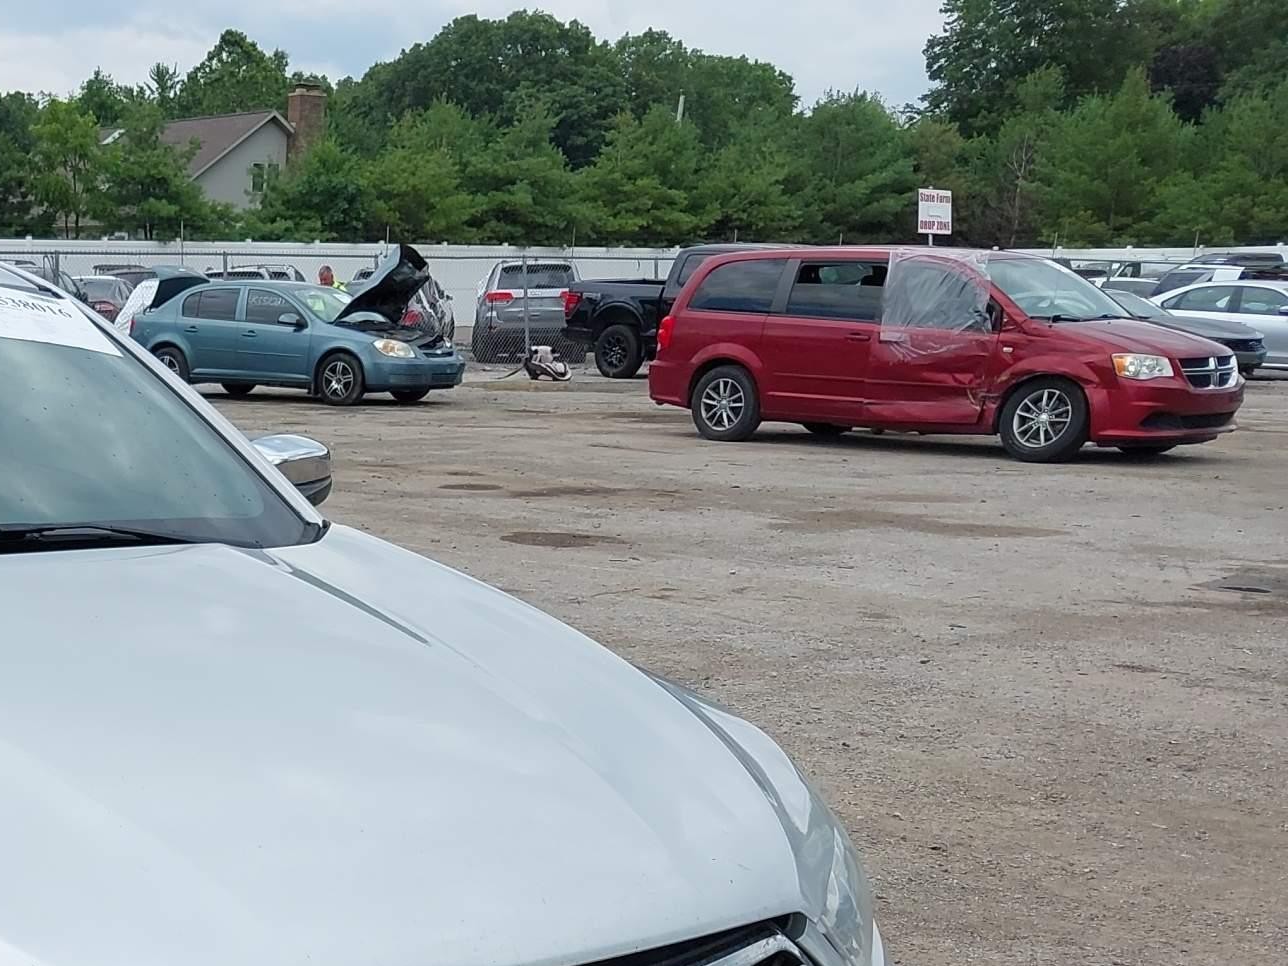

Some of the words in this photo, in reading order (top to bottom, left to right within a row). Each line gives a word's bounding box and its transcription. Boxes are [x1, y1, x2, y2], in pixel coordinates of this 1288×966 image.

[920, 192, 935, 203] State
[936, 193, 951, 204] Farm
[920, 220, 935, 230] DROP
[936, 221, 950, 231] ZONE
